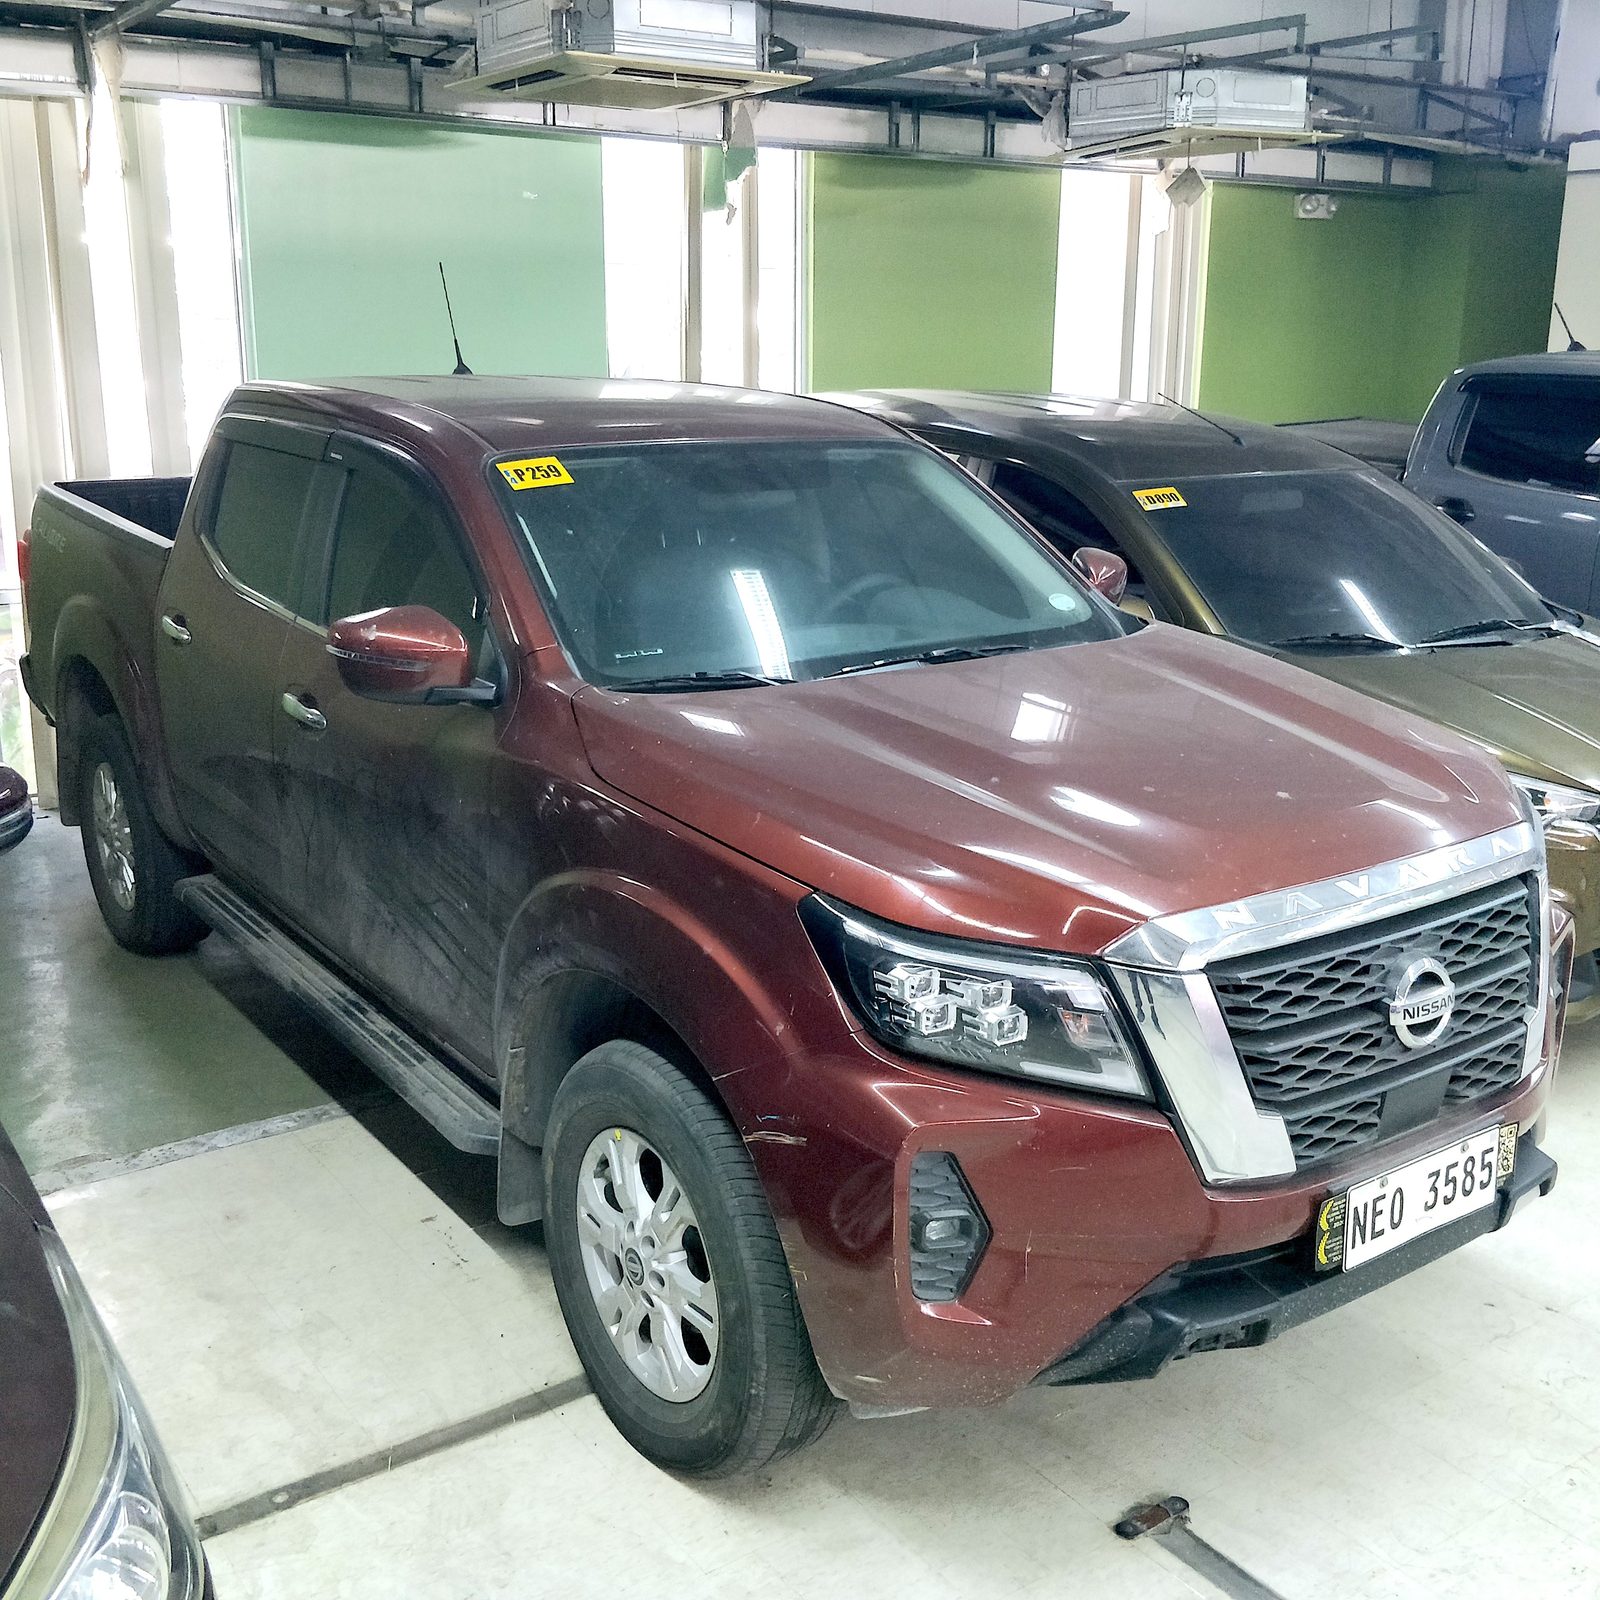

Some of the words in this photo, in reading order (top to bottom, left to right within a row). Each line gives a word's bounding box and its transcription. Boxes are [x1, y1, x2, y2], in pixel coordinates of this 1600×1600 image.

[513, 464, 562, 481] P259
[1213, 835, 1517, 930] NAVARA
[1402, 993, 1454, 1020] NISSAN
[1351, 1187, 1404, 1249] NEO
[1424, 1147, 1494, 1212] 3585
